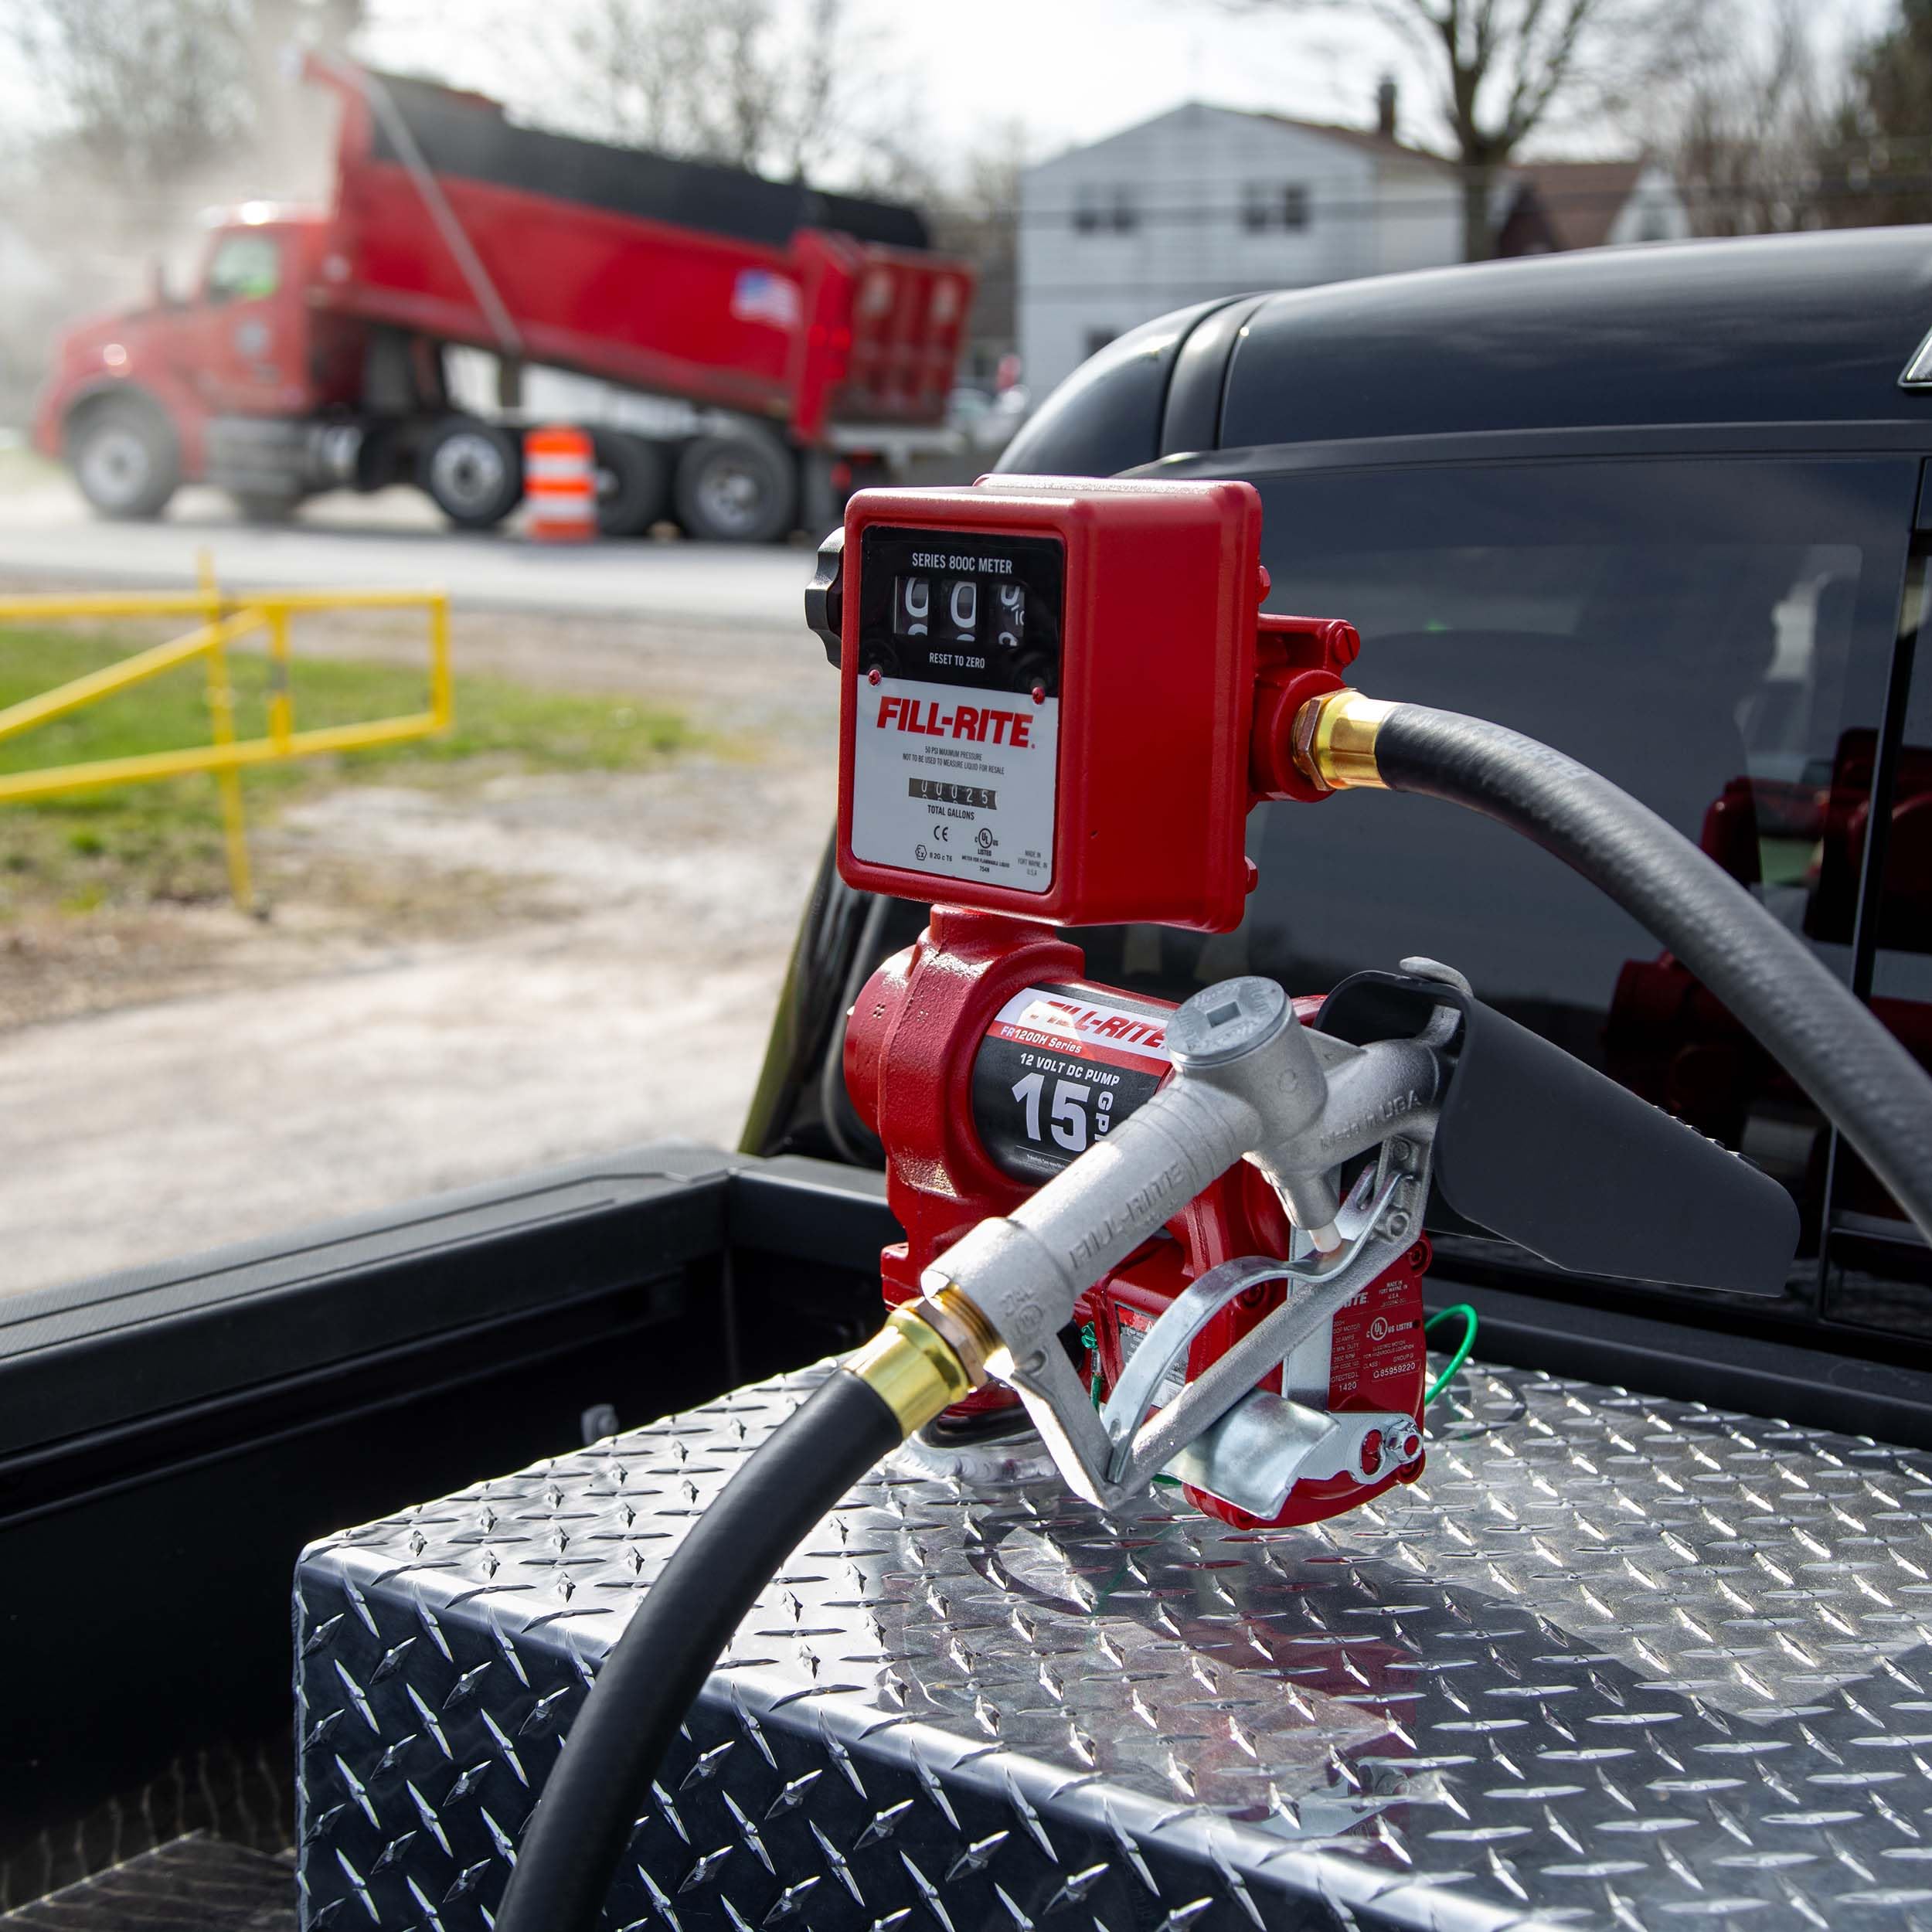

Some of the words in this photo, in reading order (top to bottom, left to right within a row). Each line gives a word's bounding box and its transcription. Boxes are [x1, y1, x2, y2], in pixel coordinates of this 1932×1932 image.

[912, 553, 946, 569] SERIES
[949, 555, 975, 571] 800C
[978, 558, 1012, 574] METER
[929, 652, 952, 665] RESET
[954, 655, 964, 667] TO
[966, 656, 985, 668] ZERO
[876, 696, 1033, 748] FILL-RITE
[939, 748, 959, 757] MAXIMUM
[960, 751, 982, 760] PRESSURE
[924, 757, 937, 765] USED
[937, 757, 943, 766] TO
[943, 759, 964, 768] MEASURE
[964, 762, 978, 770] LIQUID
[988, 765, 1005, 774] RESALE
[927, 804, 945, 816] TOTAL
[947, 808, 975, 821] GALLONS
[934, 825, 948, 842] CE
[1000, 1025, 1047, 1045] FR1200H
[1048, 1036, 1082, 1053] Series
[1020, 1053, 1034, 1066] 12
[1036, 1056, 1066, 1073] VOLT
[1066, 1064, 1083, 1078] DC
[1084, 1069, 1121, 1086] PUMP
[1012, 1073, 1091, 1152] 15
[1382, 1090, 1422, 1119] USA
[1094, 1091, 1114, 1141] GP
[1338, 1382, 1357, 1391] 1420
